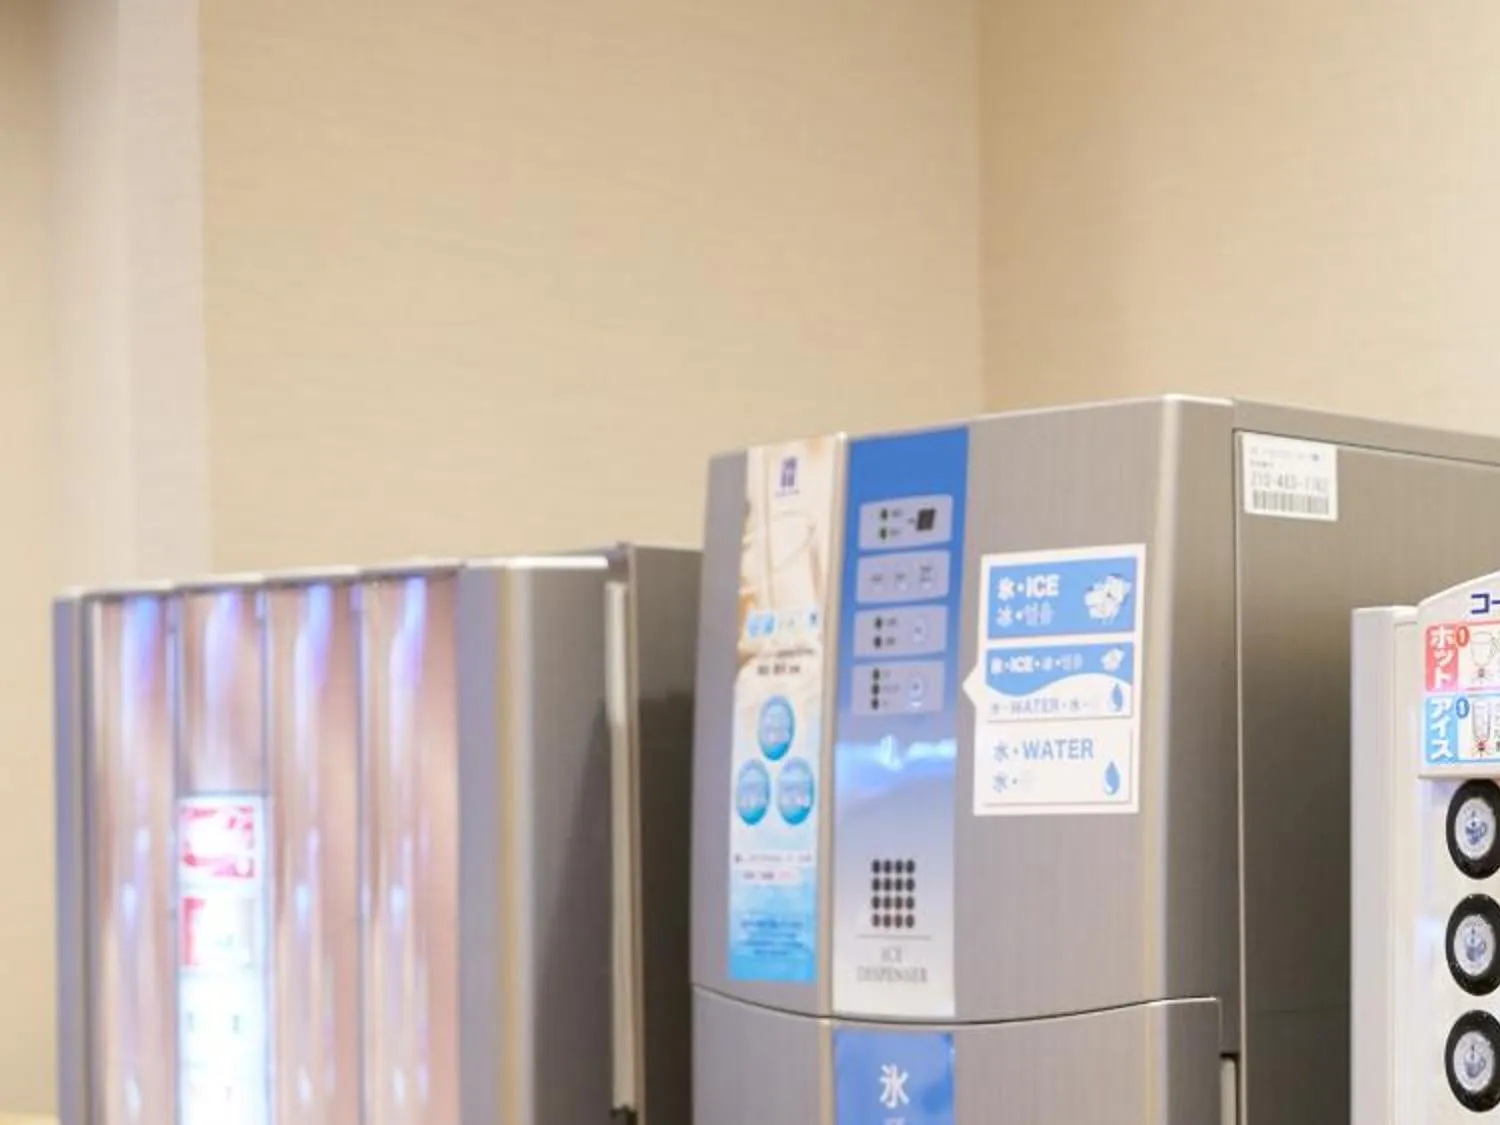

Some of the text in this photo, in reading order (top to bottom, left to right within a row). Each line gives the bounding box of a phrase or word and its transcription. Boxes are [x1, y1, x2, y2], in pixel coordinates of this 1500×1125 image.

[1430, 626, 1455, 689] ホット
[1431, 699, 1454, 760] アイス
[879, 1064, 910, 1109] 氷
